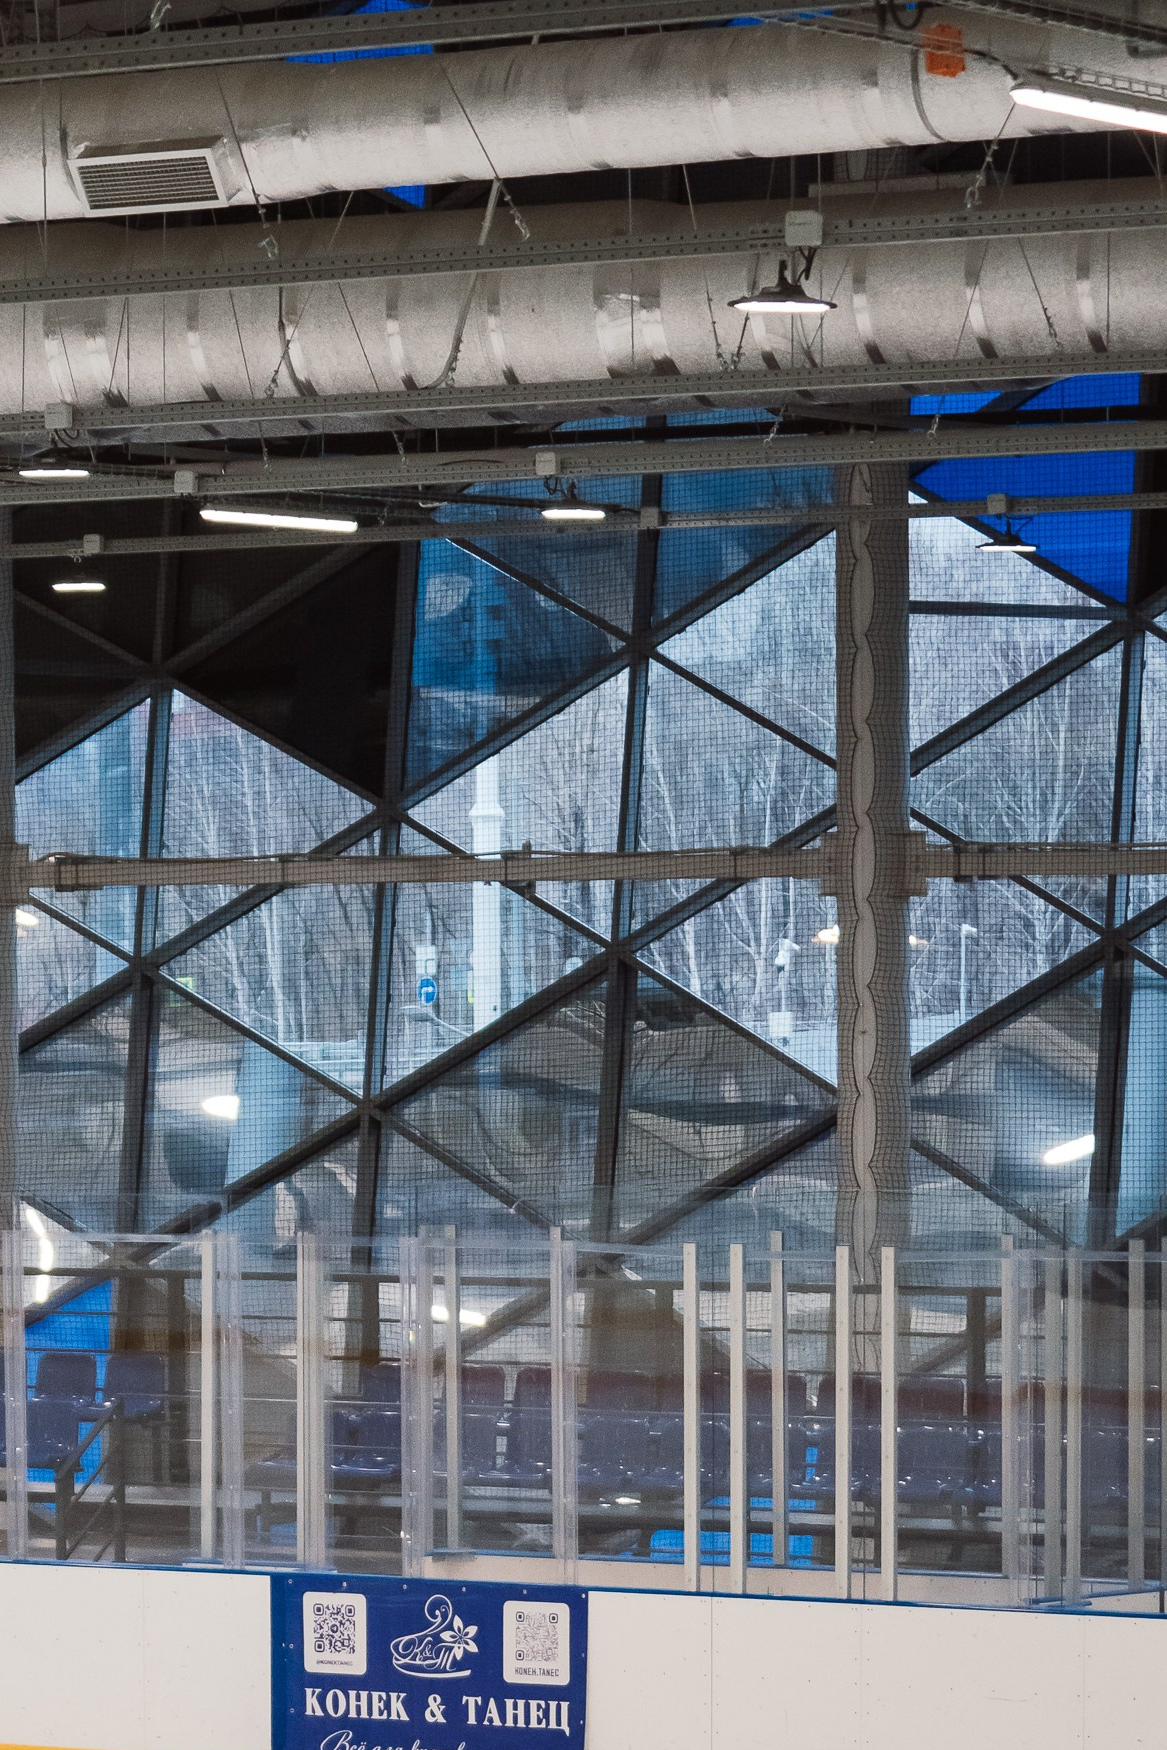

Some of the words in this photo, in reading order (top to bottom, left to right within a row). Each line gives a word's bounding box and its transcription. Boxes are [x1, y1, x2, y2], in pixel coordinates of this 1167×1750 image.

[304, 1687, 410, 1721] КОНЕК
[424, 1693, 446, 1723] &
[462, 1695, 570, 1735] ТАНЕЦ
